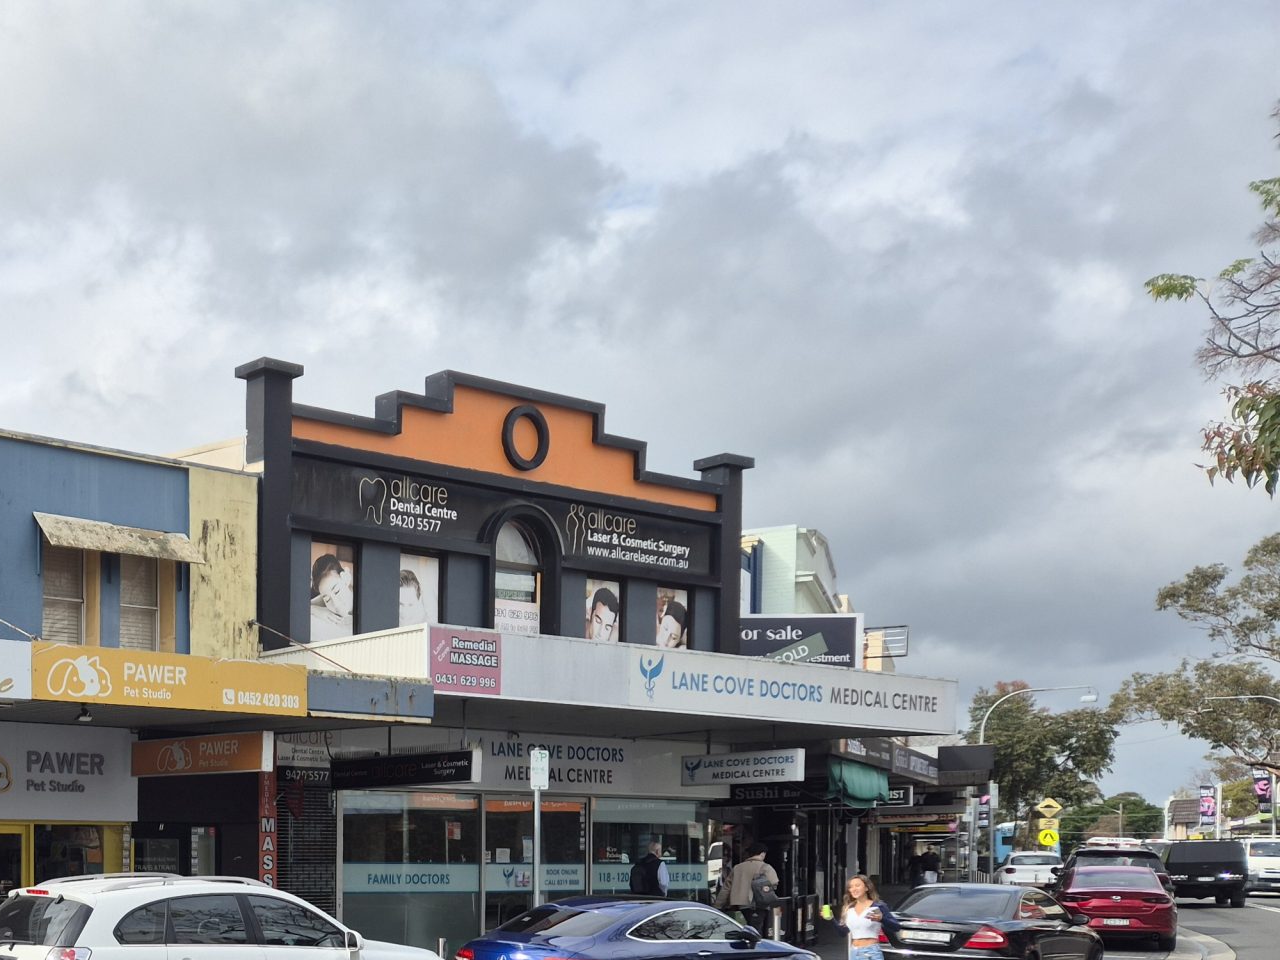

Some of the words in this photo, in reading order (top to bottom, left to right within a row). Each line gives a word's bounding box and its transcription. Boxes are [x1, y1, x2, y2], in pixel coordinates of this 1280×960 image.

[390, 475, 448, 505] allcare
[390, 498, 423, 515] Dental
[424, 503, 458, 520] Centre
[389, 513, 415, 529] 9420
[416, 518, 441, 533] 5577
[587, 509, 637, 535] allcare
[587, 529, 611, 544] Laser
[612, 533, 620, 545] &
[620, 534, 658, 551] Cosmetic
[659, 540, 690, 558] Surgery
[587, 545, 689, 569] www.allcarelaser.com.au
[740, 629, 762, 641] or
[766, 625, 803, 641] sale
[452, 636, 497, 653] Remedial
[450, 651, 499, 668] MASSAGE
[806, 653, 851, 663] estment
[123, 662, 188, 686] PAWER
[435, 673, 458, 685] 0431
[460, 675, 477, 687] 629
[479, 677, 496, 688] 996
[123, 686, 139, 697] Pet
[142, 687, 172, 700] Studio
[237, 691, 261, 706] 0452
[262, 693, 281, 707] 420
[281, 694, 300, 709] 303
[671, 671, 709, 692] LANE
[712, 674, 755, 696] COVE
[759, 679, 823, 703] DOCTORS
[829, 686, 889, 709] MEDICAL
[891, 692, 938, 713] CENTRE
[199, 740, 239, 756] PAWER
[491, 741, 523, 757] LANE
[567, 745, 625, 762] DOCTORS
[26, 750, 105, 776] PAWER
[442, 758, 469, 768] Cosmetic
[703, 759, 724, 769] LANE
[726, 758, 750, 768] COVE
[753, 755, 795, 766] DOCTORS
[433, 768, 456, 777] Surgery
[505, 765, 564, 783] MEDAL
[566, 768, 613, 785] CENTRE
[711, 770, 750, 780] MEDICAL
[752, 768, 786, 778] CENTRE
[26, 779, 46, 792] Pet
[48, 778, 86, 793] Studio
[735, 786, 780, 800] Sushi
[783, 789, 801, 798] Bar
[261, 817, 276, 888] MASS
[367, 873, 402, 885] FAMILY
[405, 873, 450, 885] DOCTORS
[599, 872, 611, 883] 118
[617, 872, 630, 883] 120
[681, 872, 703, 883] ROAD
